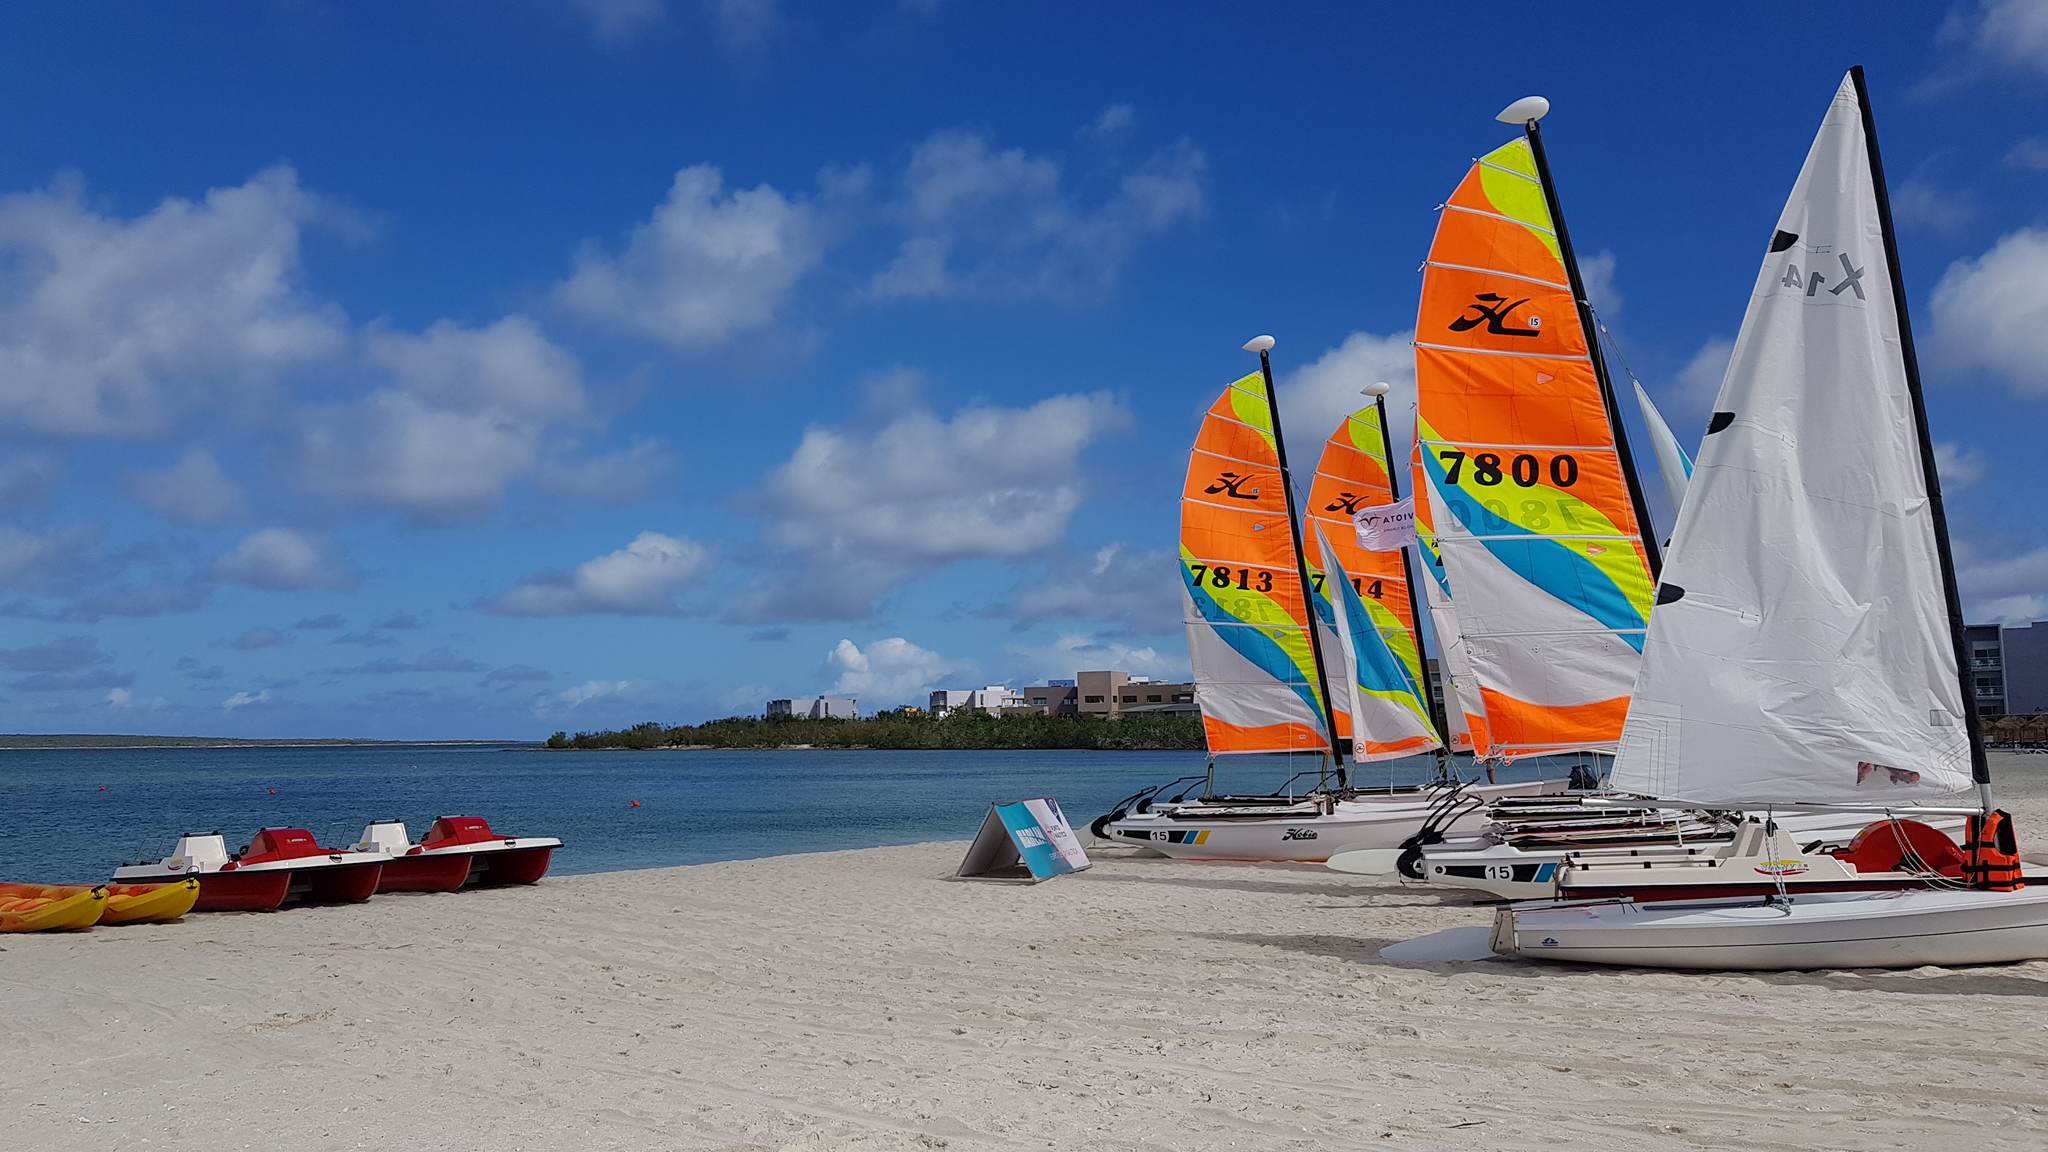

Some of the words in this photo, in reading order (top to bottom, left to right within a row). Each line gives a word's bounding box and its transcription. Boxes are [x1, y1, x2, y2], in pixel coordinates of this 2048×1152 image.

[1440, 451, 1579, 488] 7800
[1191, 565, 1273, 593] 7813
[1311, 573, 1385, 600] 714
[1152, 831, 1167, 841] 15
[1281, 828, 1318, 841] Hobie
[1488, 866, 1510, 880] 15
